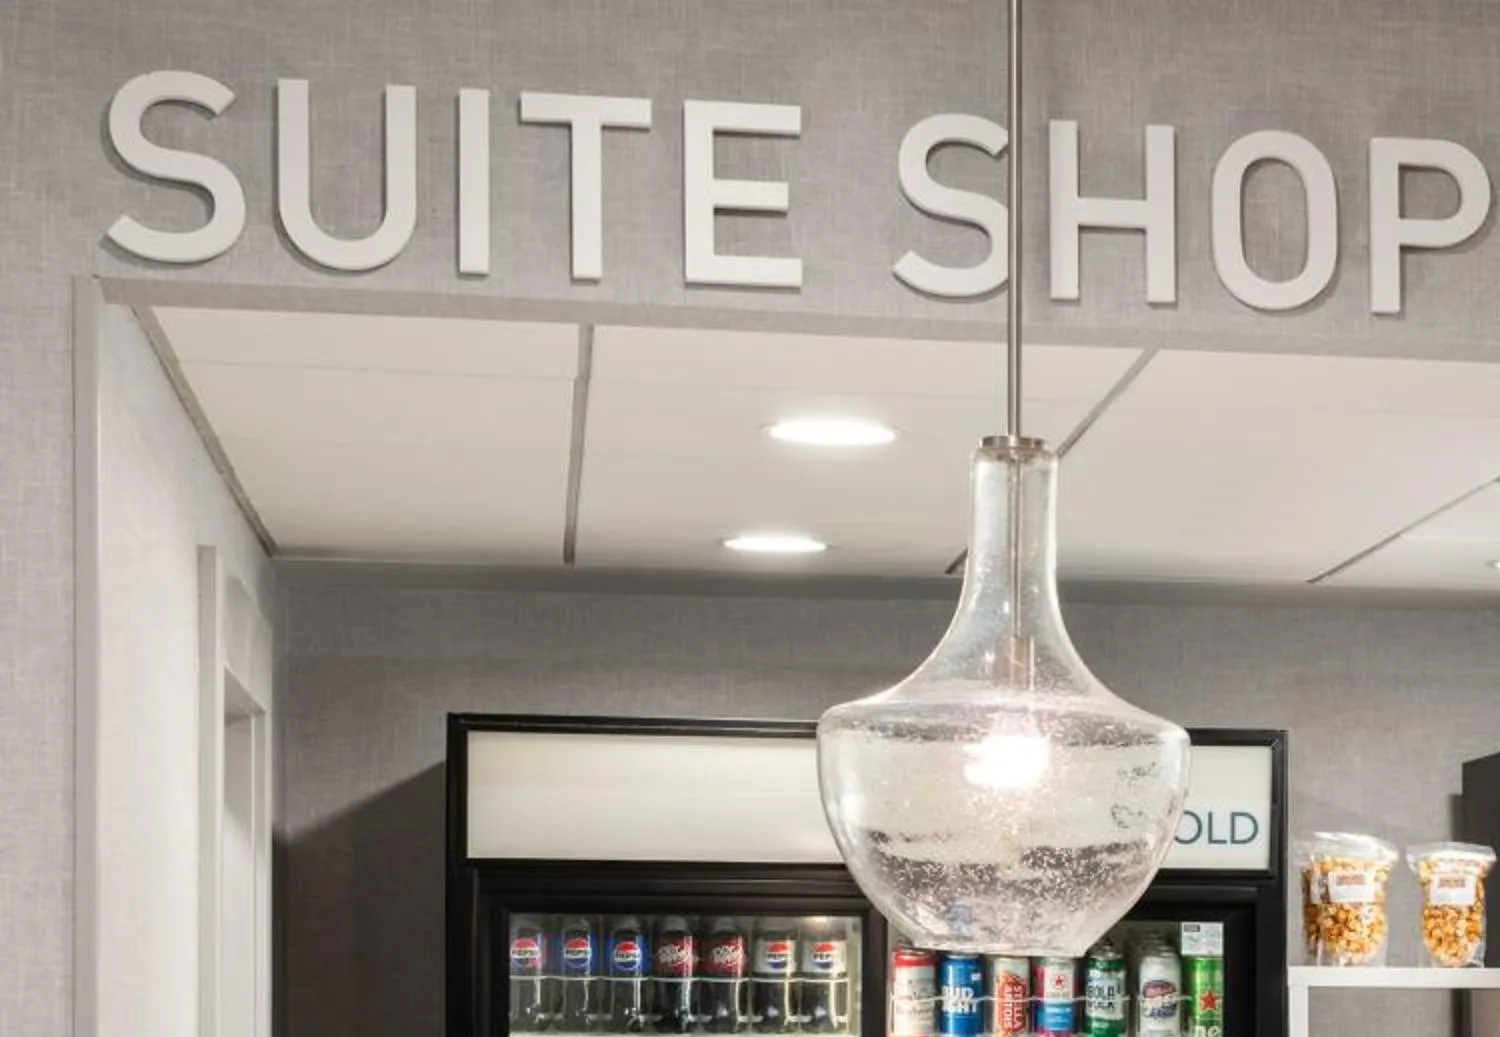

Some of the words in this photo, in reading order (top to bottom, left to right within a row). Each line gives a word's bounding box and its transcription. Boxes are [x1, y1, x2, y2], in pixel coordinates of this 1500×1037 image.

[106, 70, 802, 287] SUITE
[893, 113, 1493, 315] SHOP
[1174, 810, 1259, 844] OLD
